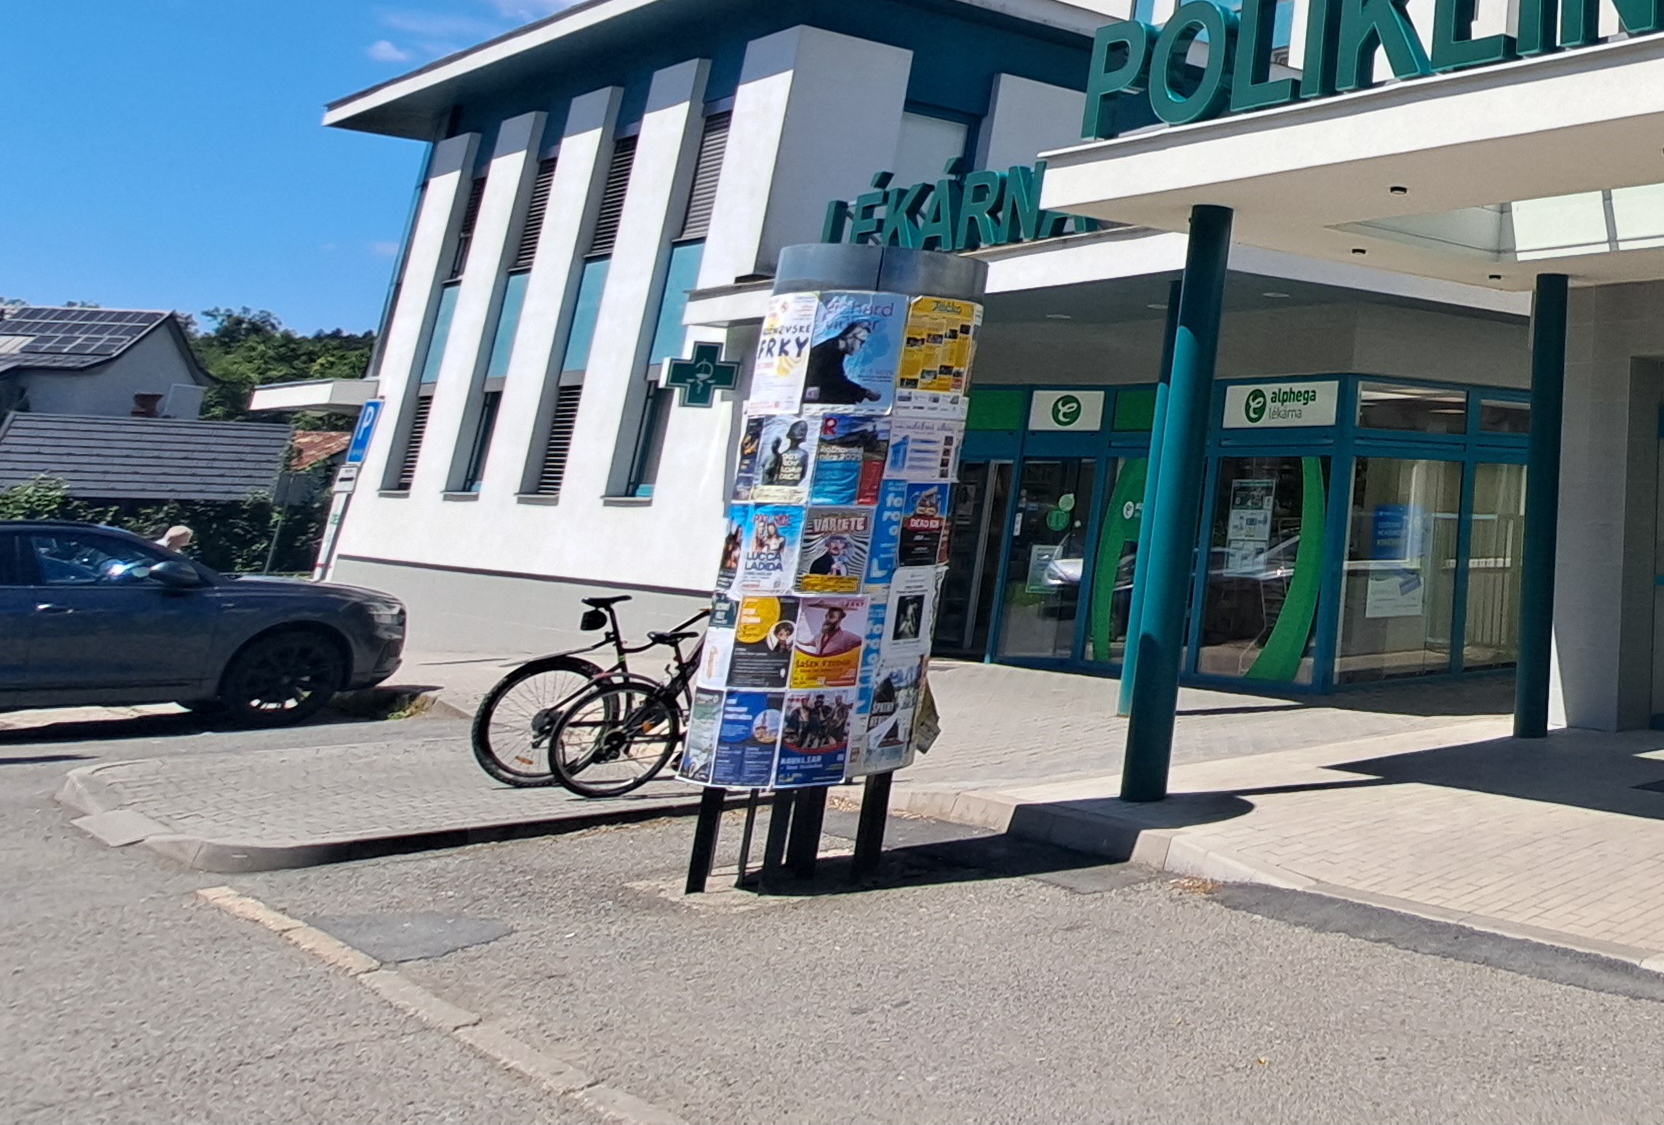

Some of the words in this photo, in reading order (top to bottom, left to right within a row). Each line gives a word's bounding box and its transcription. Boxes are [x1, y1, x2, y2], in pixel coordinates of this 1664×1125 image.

[757, 336, 810, 360] FRKY
[1270, 387, 1317, 406] alphega
[357, 406, 375, 441] P
[1269, 407, 1302, 420] lékárna
